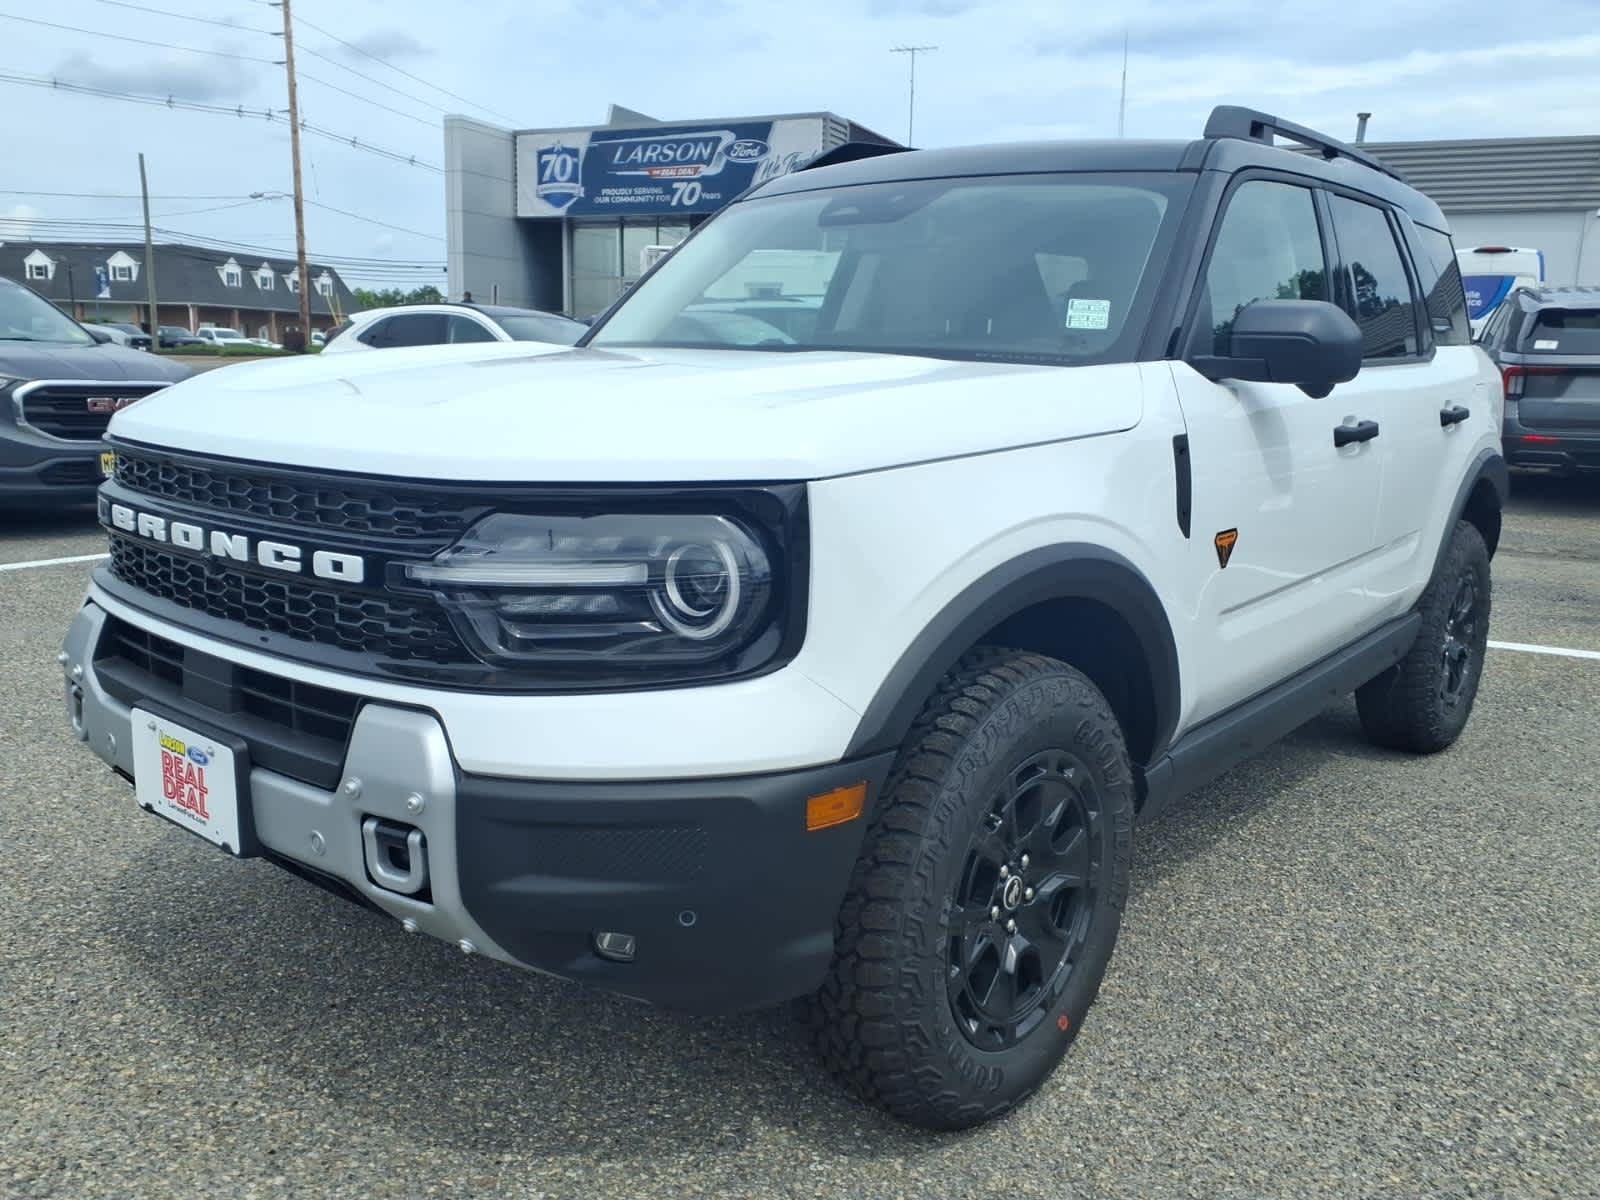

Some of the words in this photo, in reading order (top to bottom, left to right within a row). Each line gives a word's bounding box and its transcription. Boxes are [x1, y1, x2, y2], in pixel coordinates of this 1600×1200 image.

[612, 142, 713, 165] LARSON
[730, 142, 760, 158] Ford
[541, 153, 573, 182] 70
[601, 188, 632, 196] PROUDLY
[633, 187, 663, 195] SERVING
[611, 195, 655, 204] COMMUNITY
[656, 194, 671, 203] FOR
[670, 182, 702, 206] 70
[111, 503, 365, 584] BRONCO
[162, 750, 208, 795] REAL
[163, 774, 209, 820] DEAL
